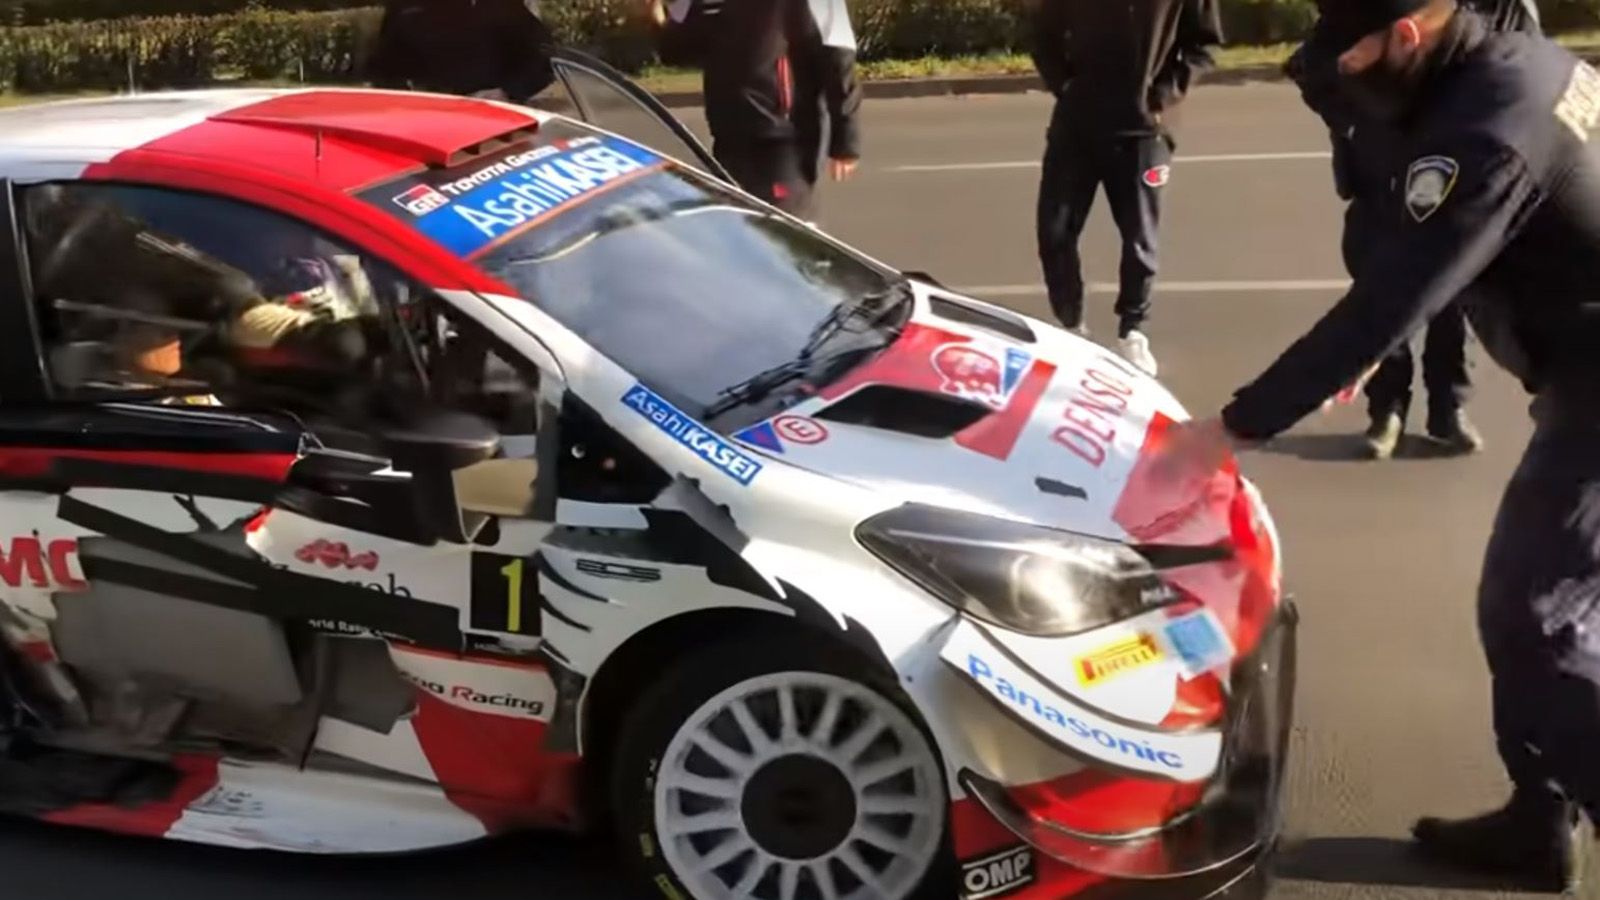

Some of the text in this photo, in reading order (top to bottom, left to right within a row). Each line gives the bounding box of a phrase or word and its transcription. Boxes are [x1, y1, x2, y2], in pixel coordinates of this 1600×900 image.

[439, 162, 512, 195] TOYOTA
[1050, 367, 1133, 470] DENSO
[501, 558, 523, 632] 1
[450, 685, 546, 716] Racing
[967, 654, 1185, 769] Panasonic
[964, 851, 1031, 892] OMP
